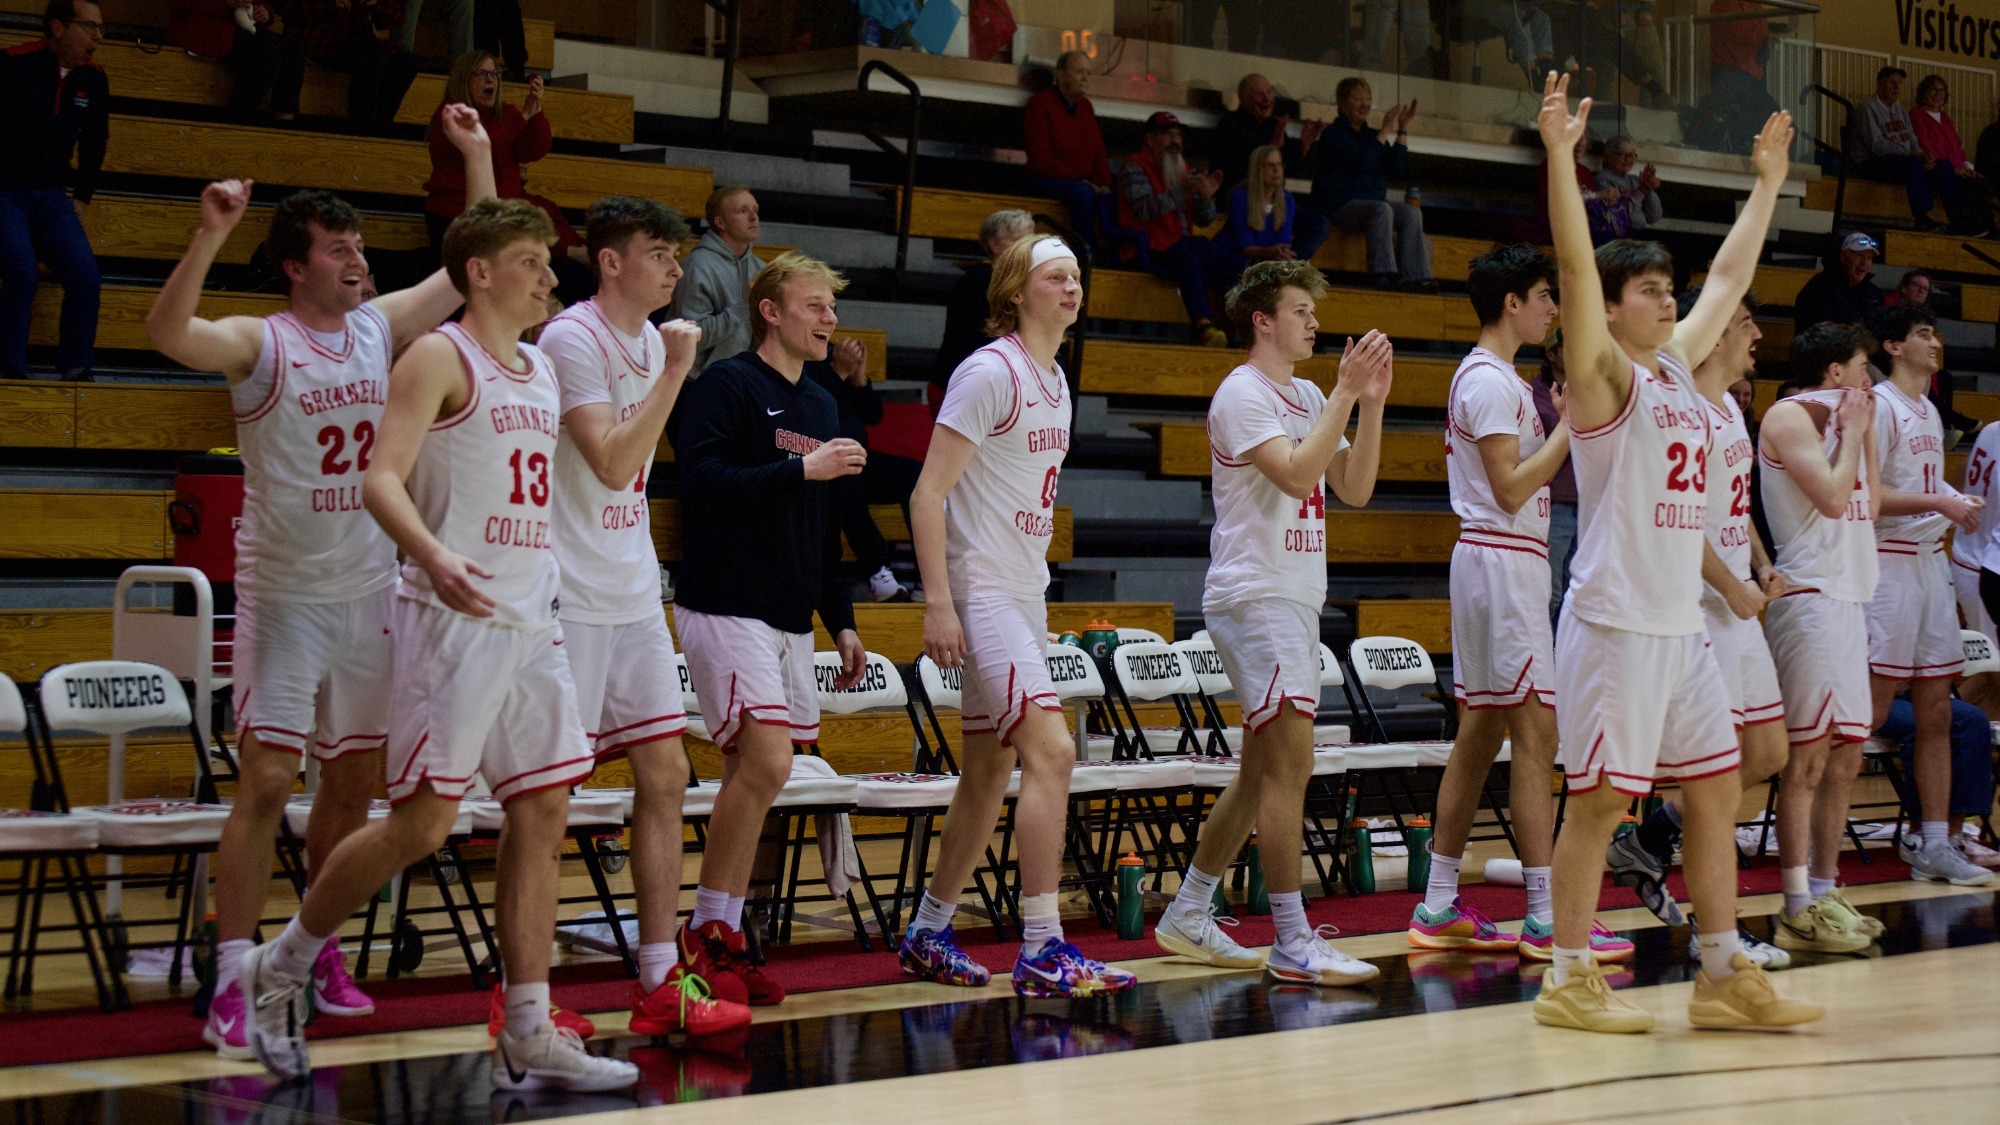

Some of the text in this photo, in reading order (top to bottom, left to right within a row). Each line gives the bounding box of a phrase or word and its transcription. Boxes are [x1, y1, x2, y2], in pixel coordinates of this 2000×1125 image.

[1894, 0, 2000, 60] Visitors
[317, 420, 376, 476] 22
[775, 428, 825, 456] GRINNE
[509, 448, 550, 508] 13
[1666, 442, 1706, 493] 23
[1923, 463, 1937, 494] 11
[1041, 465, 1057, 509] 0
[1655, 502, 1707, 530] COLLE
[1126, 653, 1182, 681] PIONEERS
[1364, 646, 1421, 670] PIONEERS
[65, 675, 165, 709] PIONEERS
